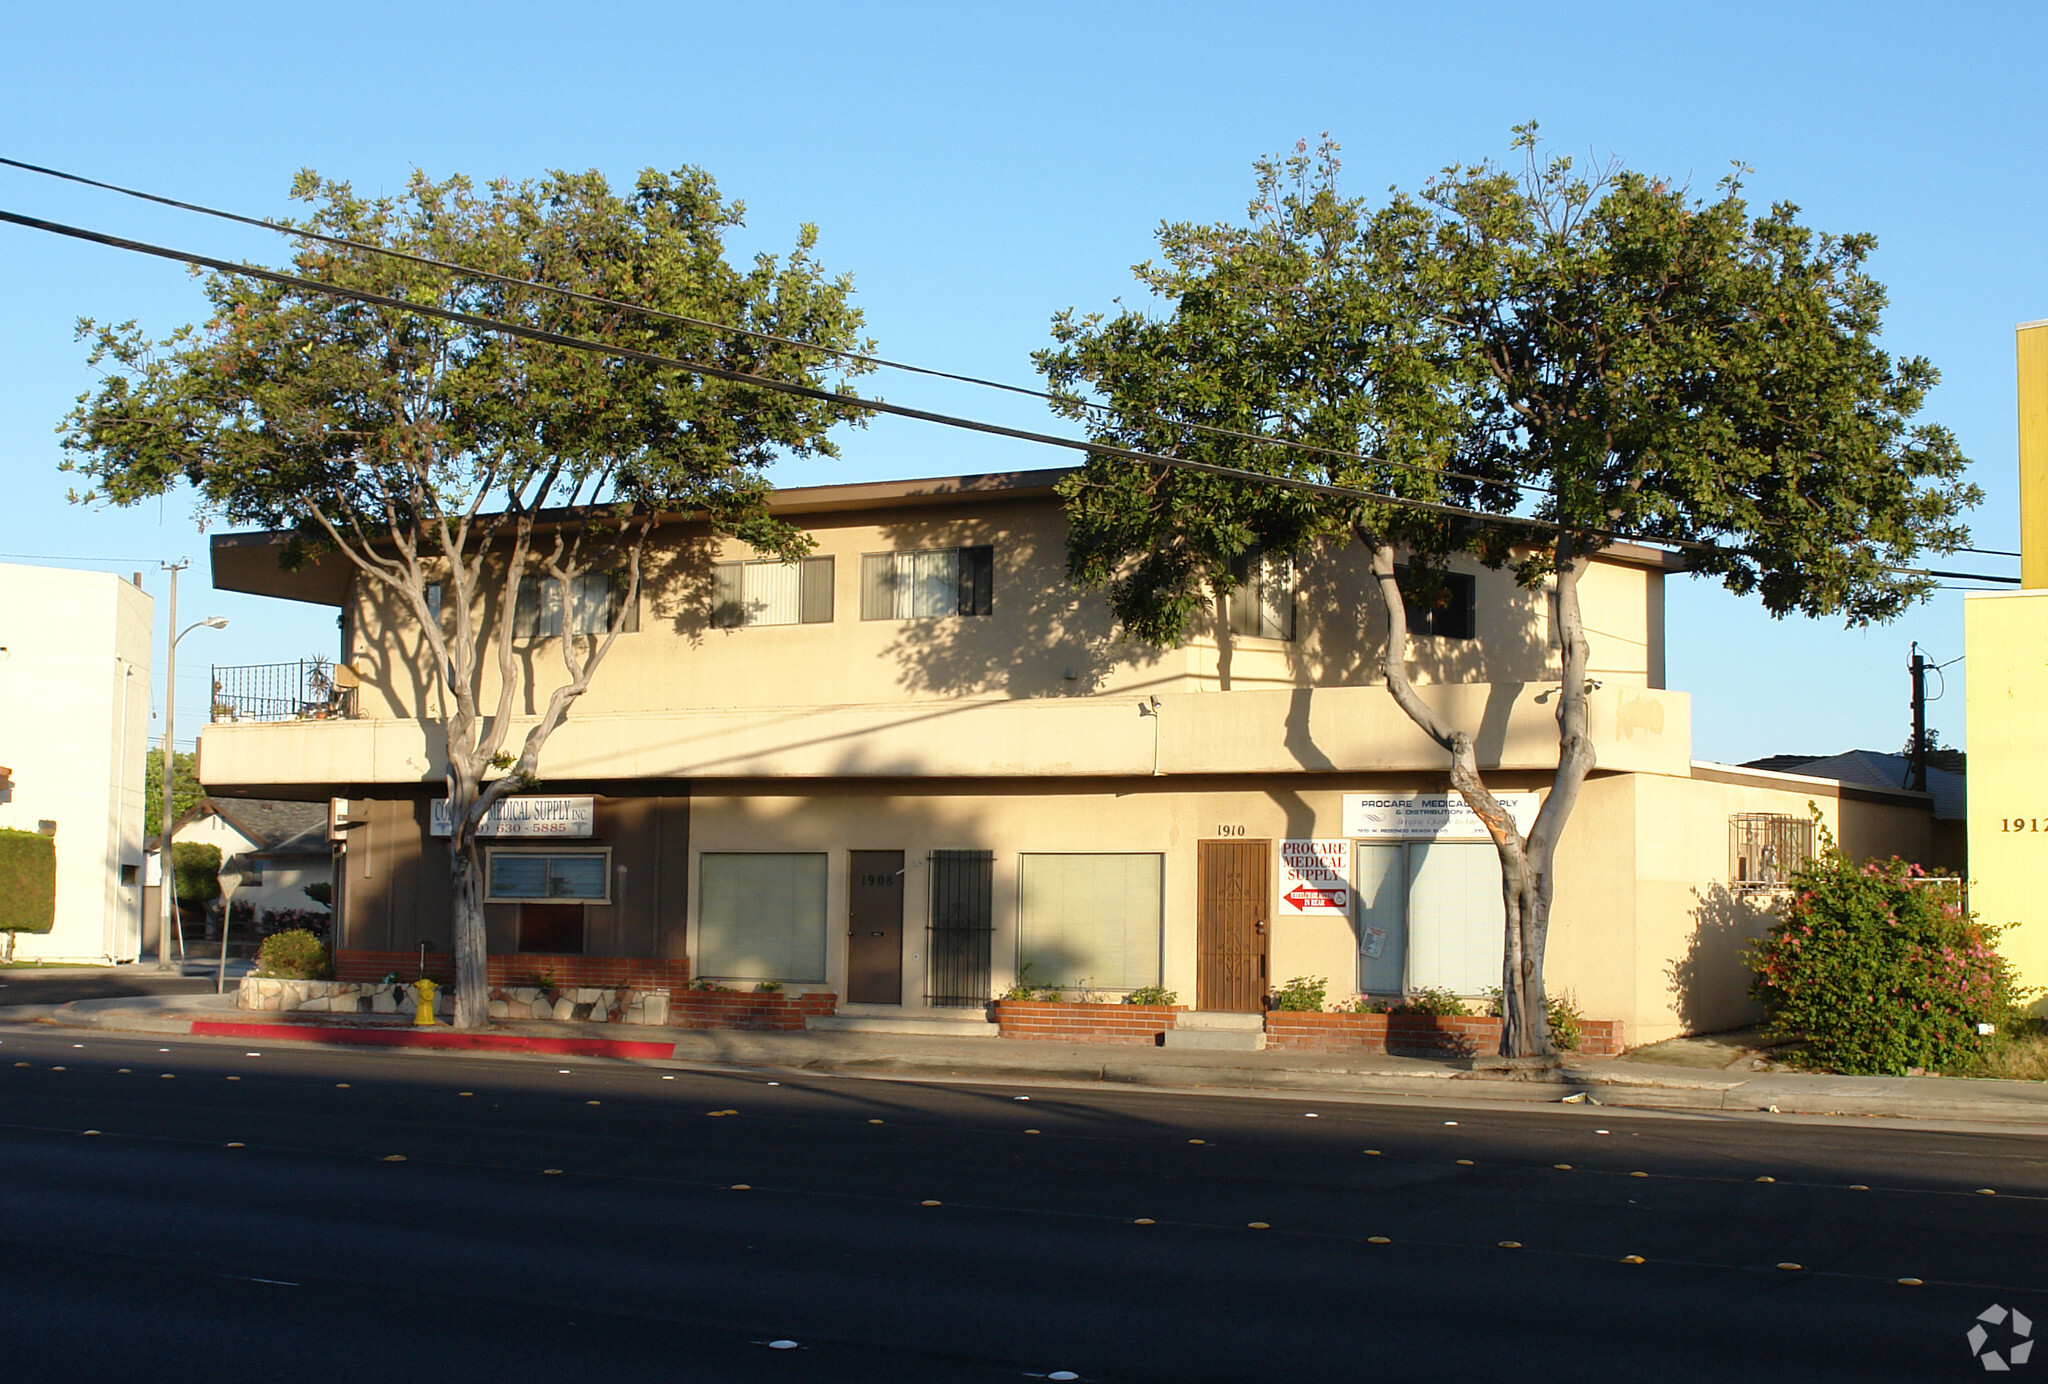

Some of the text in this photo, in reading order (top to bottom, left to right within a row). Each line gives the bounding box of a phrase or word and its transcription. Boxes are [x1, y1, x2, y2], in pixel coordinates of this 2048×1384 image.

[1361, 800, 1413, 808] PROCARE
[488, 800, 588, 821] MEDICAL SUPPLY INC.
[496, 823, 521, 833] 630
[532, 823, 567, 833] 5885
[1217, 824, 1245, 837] 1910
[1282, 842, 1347, 855] PROCARE
[1283, 856, 1346, 868] MEDICAL
[862, 875, 893, 886] 1908
[1287, 868, 1341, 881] SUPPLY
